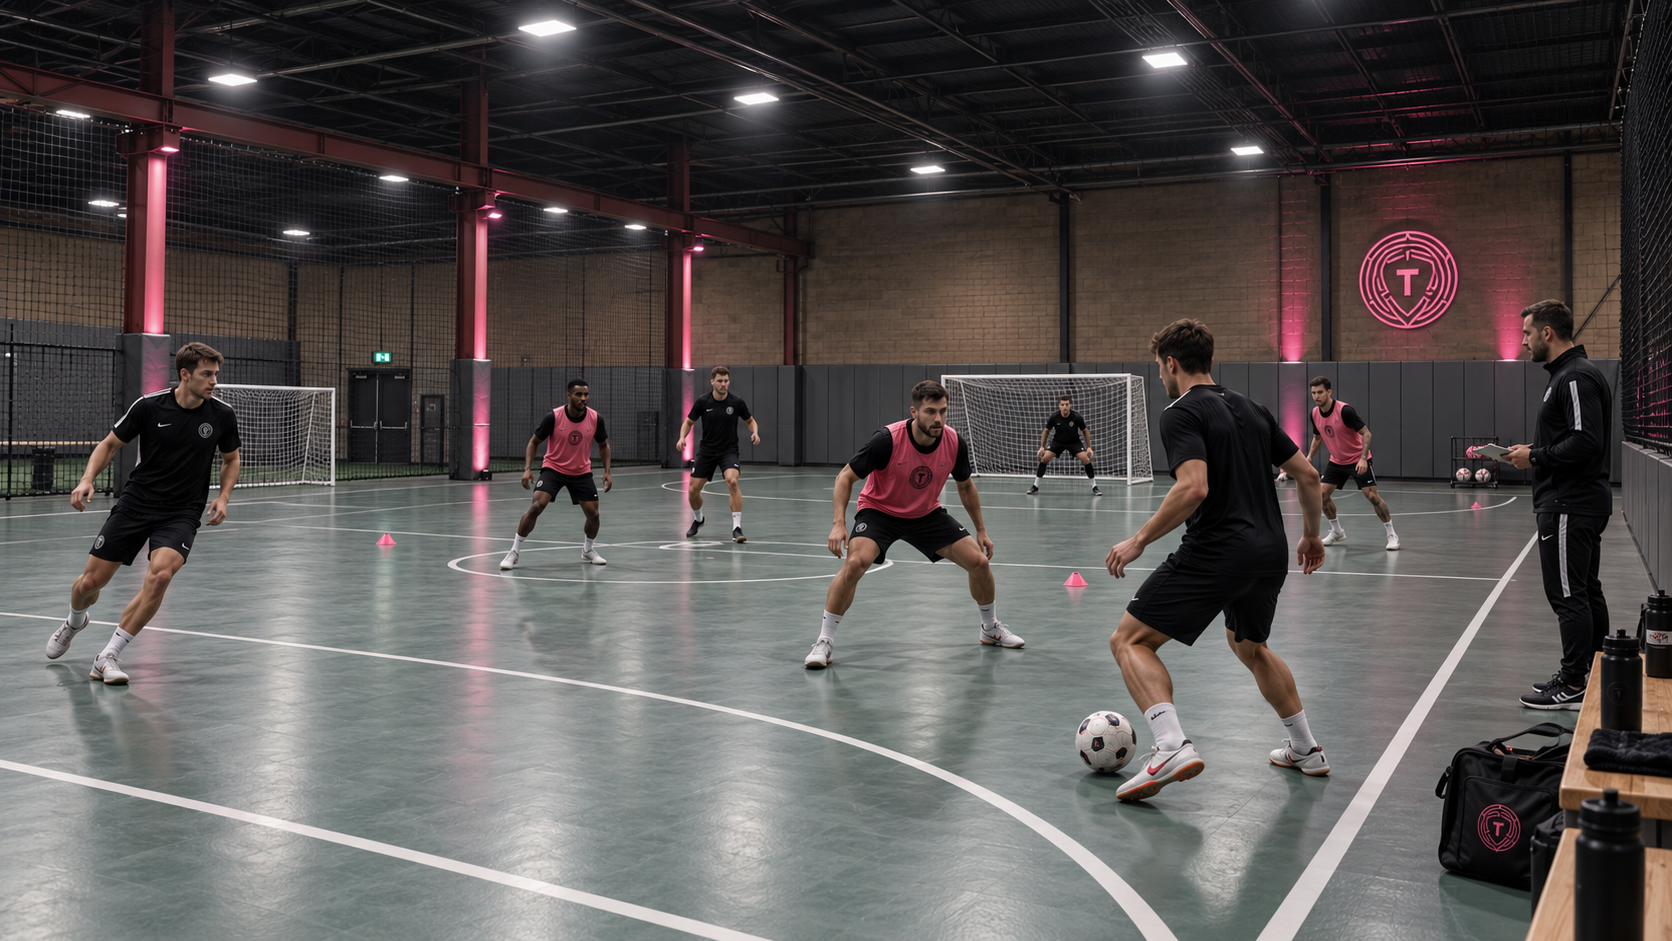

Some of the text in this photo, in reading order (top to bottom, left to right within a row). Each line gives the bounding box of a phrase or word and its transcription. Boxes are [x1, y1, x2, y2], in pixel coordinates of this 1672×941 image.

[1396, 269, 1419, 296] T
[917, 473, 926, 484] T
[1493, 822, 1504, 836] T
